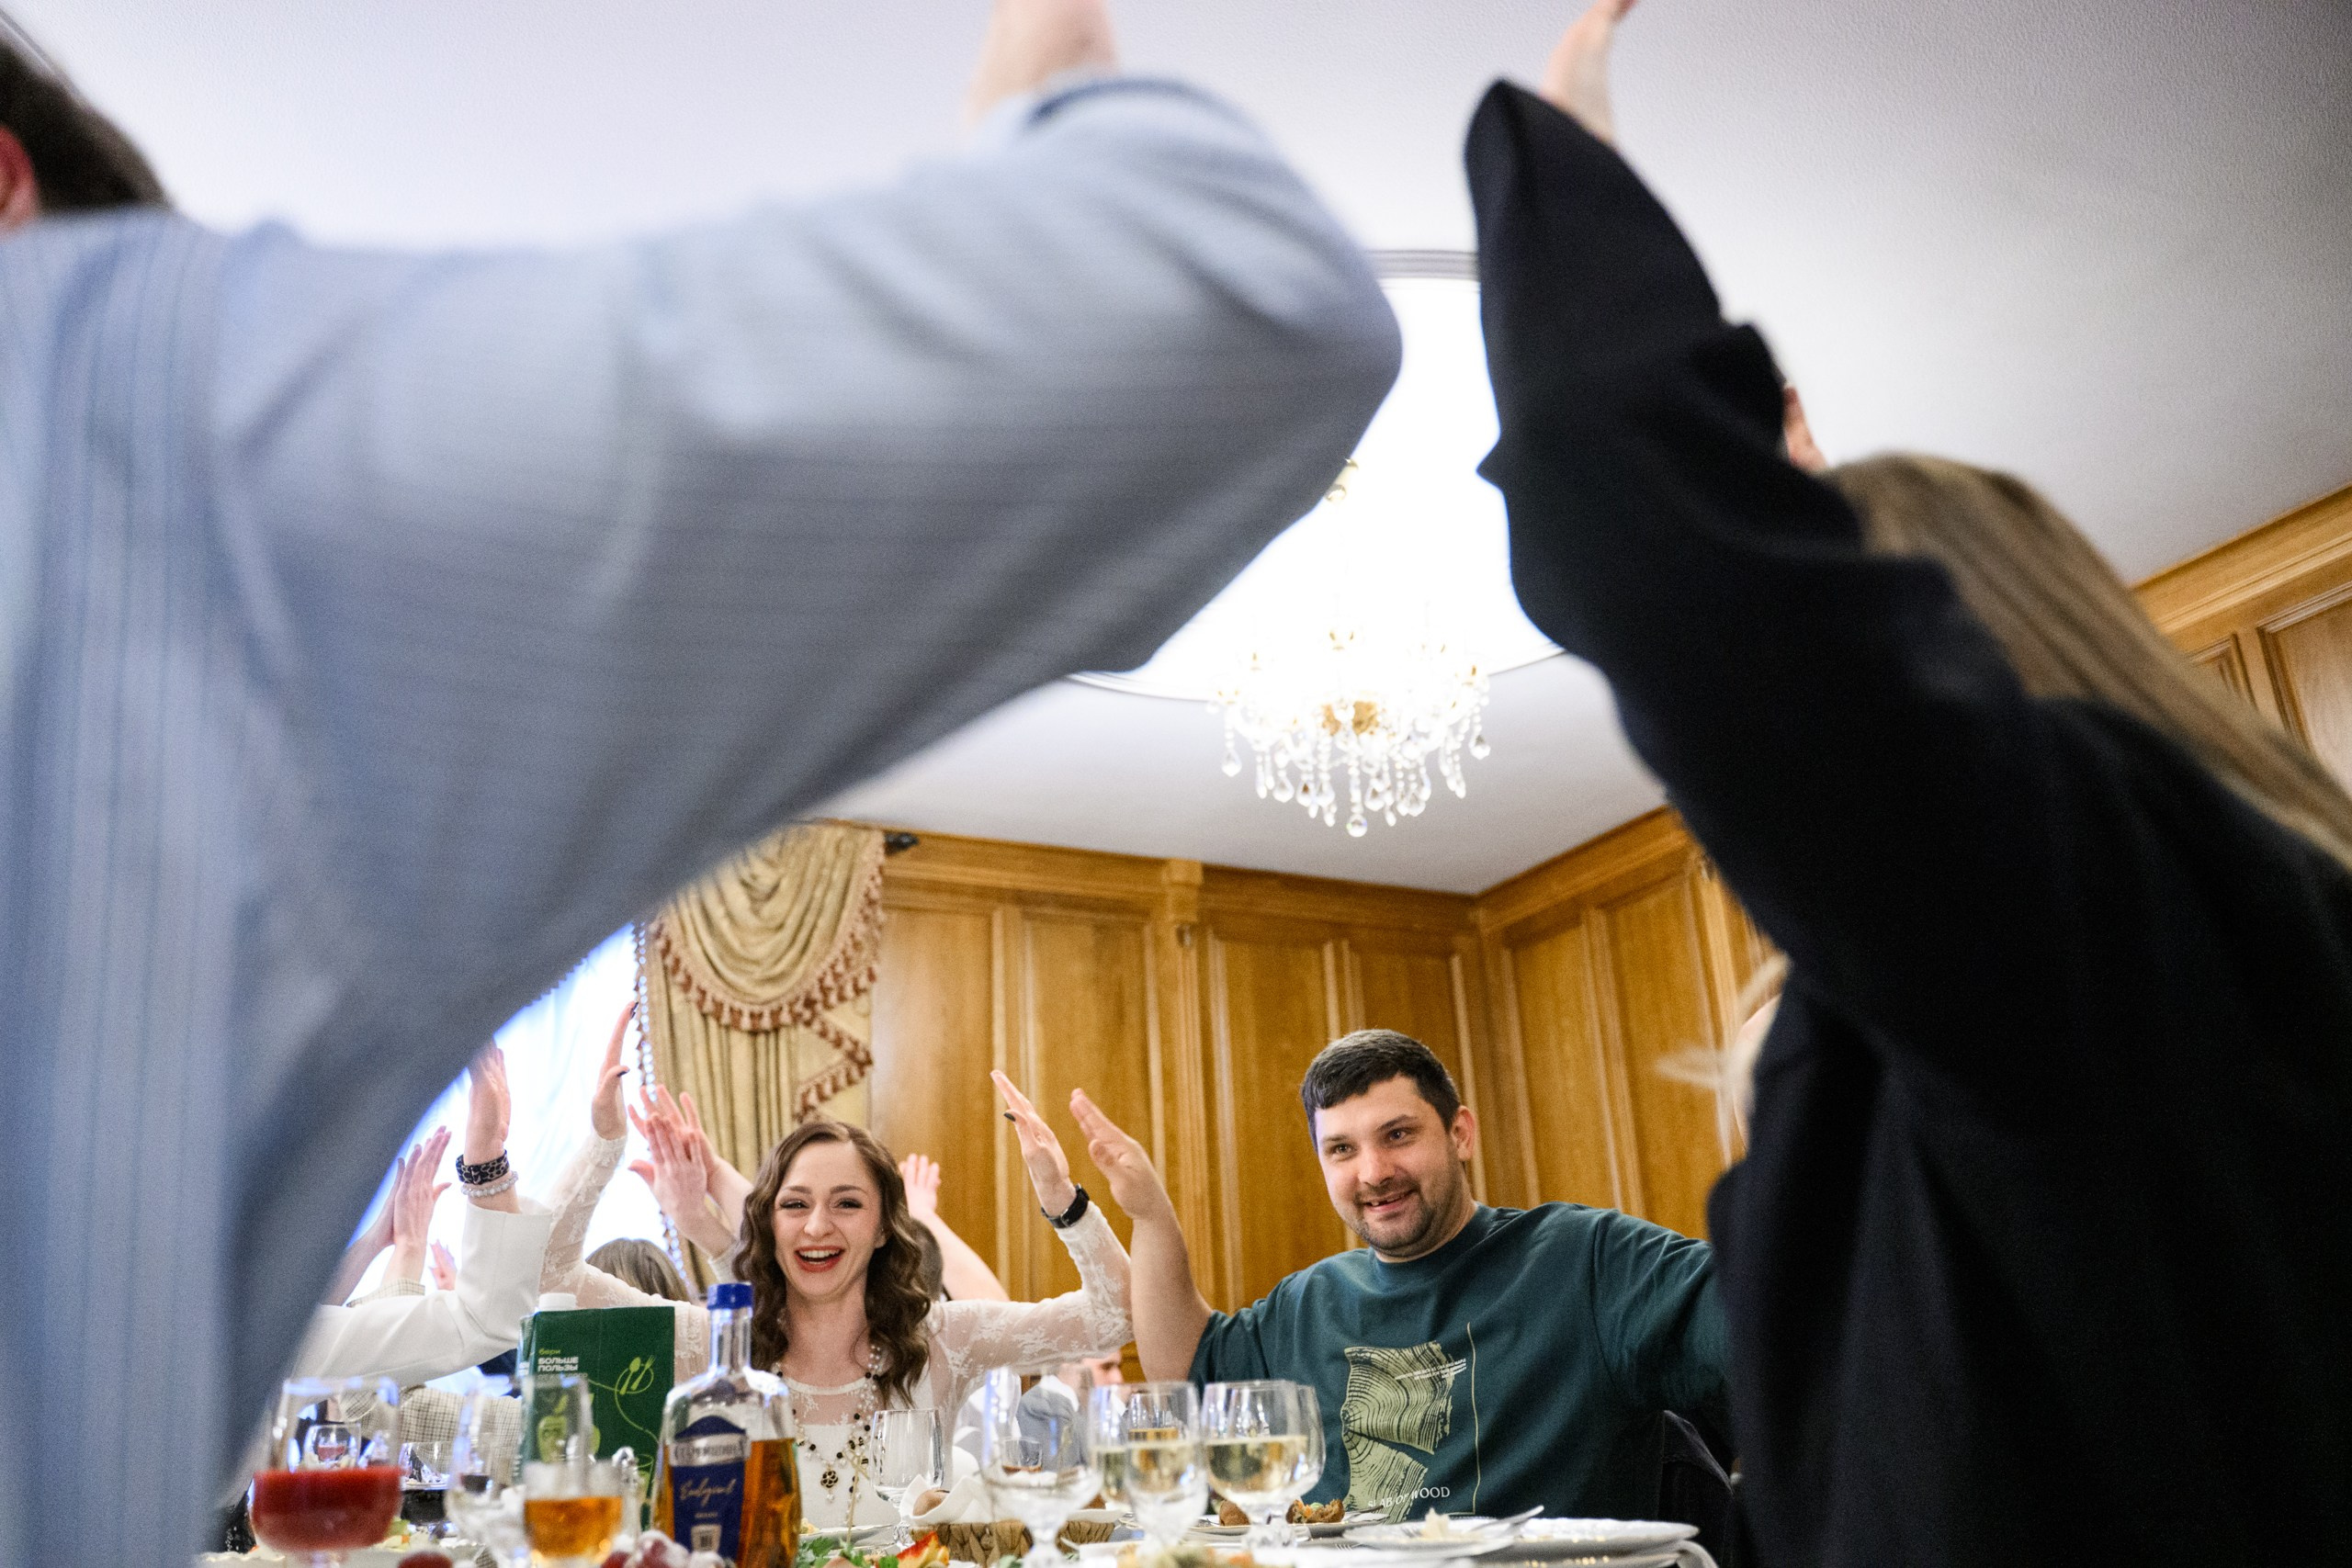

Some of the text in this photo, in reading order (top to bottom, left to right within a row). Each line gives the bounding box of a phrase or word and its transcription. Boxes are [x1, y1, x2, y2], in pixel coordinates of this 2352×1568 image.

[538, 1348, 561, 1356] бери
[537, 1357, 579, 1365] БОЛЬШЕ
[537, 1364, 579, 1372] ПОЛЬЗЫ
[1411, 1486, 1451, 1500] WOOD
